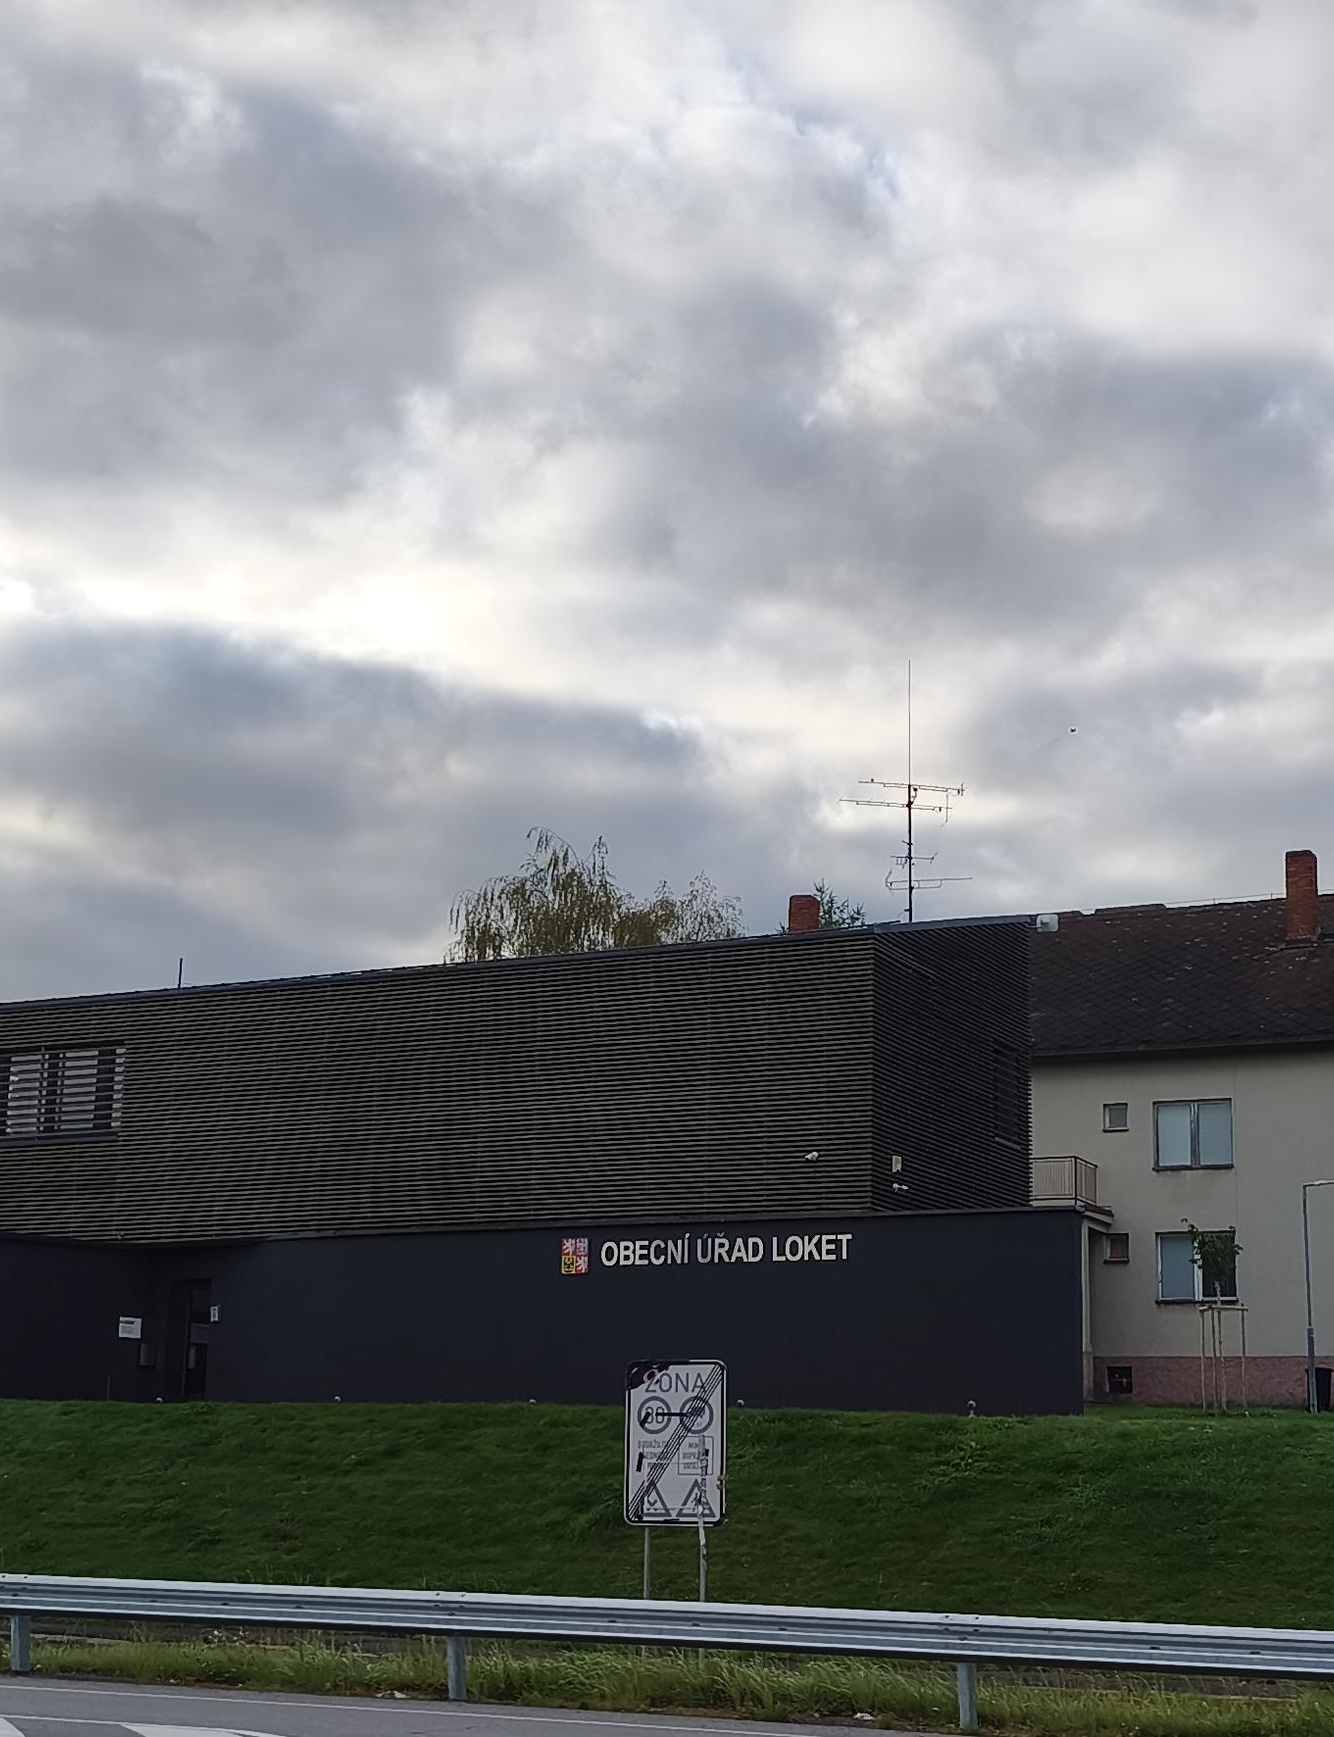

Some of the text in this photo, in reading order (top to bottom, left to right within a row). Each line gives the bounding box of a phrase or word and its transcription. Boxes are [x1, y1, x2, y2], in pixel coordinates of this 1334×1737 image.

[600, 1231, 853, 1267] OBECNÍ ÚŘAD LOKET
